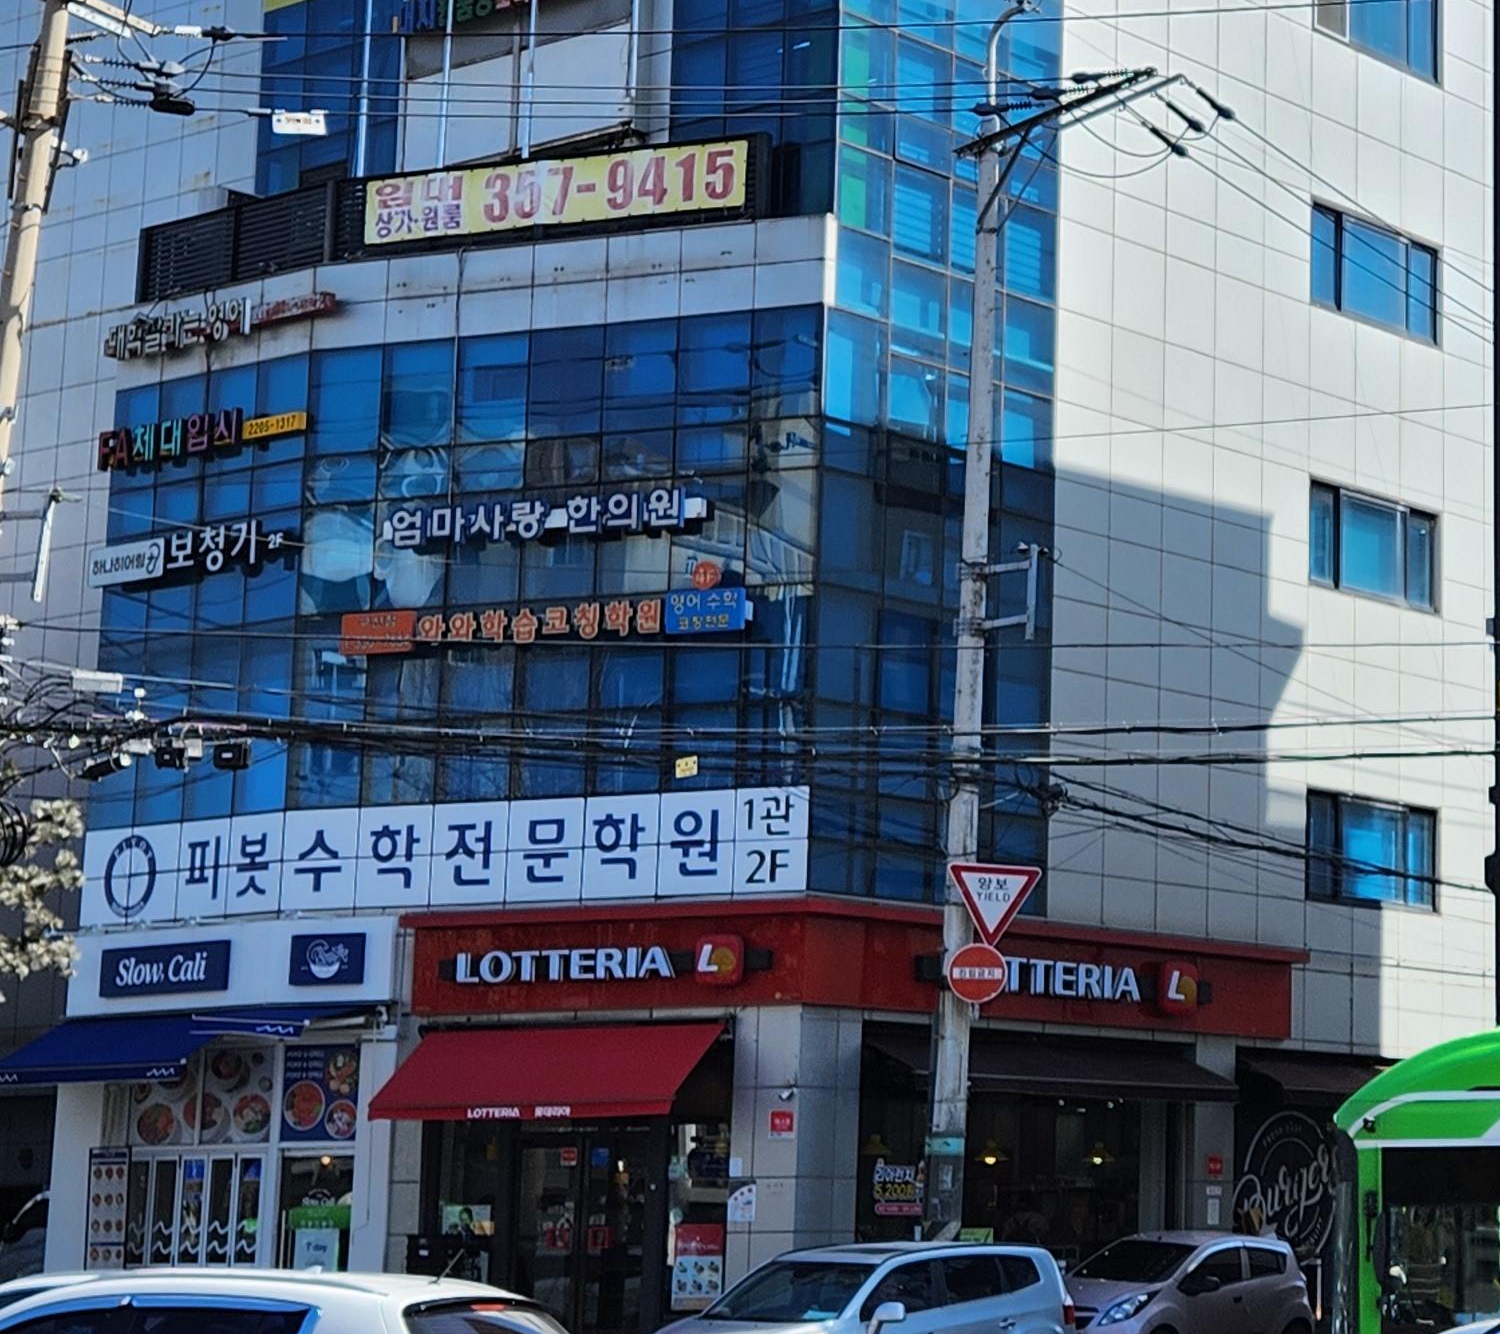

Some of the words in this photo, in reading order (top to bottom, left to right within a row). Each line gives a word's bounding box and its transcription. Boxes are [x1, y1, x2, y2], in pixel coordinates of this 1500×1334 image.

[483, 148, 735, 224] 357-9415
[167, 519, 257, 572] 보청기
[268, 533, 284, 549] 2F
[418, 598, 662, 645] 와와학습코칭학원
[671, 593, 700, 615] 영어
[707, 591, 738, 611] 수학
[743, 795, 795, 836] 1관
[745, 849, 790, 884] 2F
[977, 876, 1008, 891] 양보
[976, 890, 1011, 902] YIELD
[116, 956, 164, 987] Slow
[168, 951, 208, 983] Cali
[456, 946, 675, 984] LOTTERIA
[1006, 955, 1141, 1004] TTERIA
[467, 1107, 521, 1119] LOTTERIA
